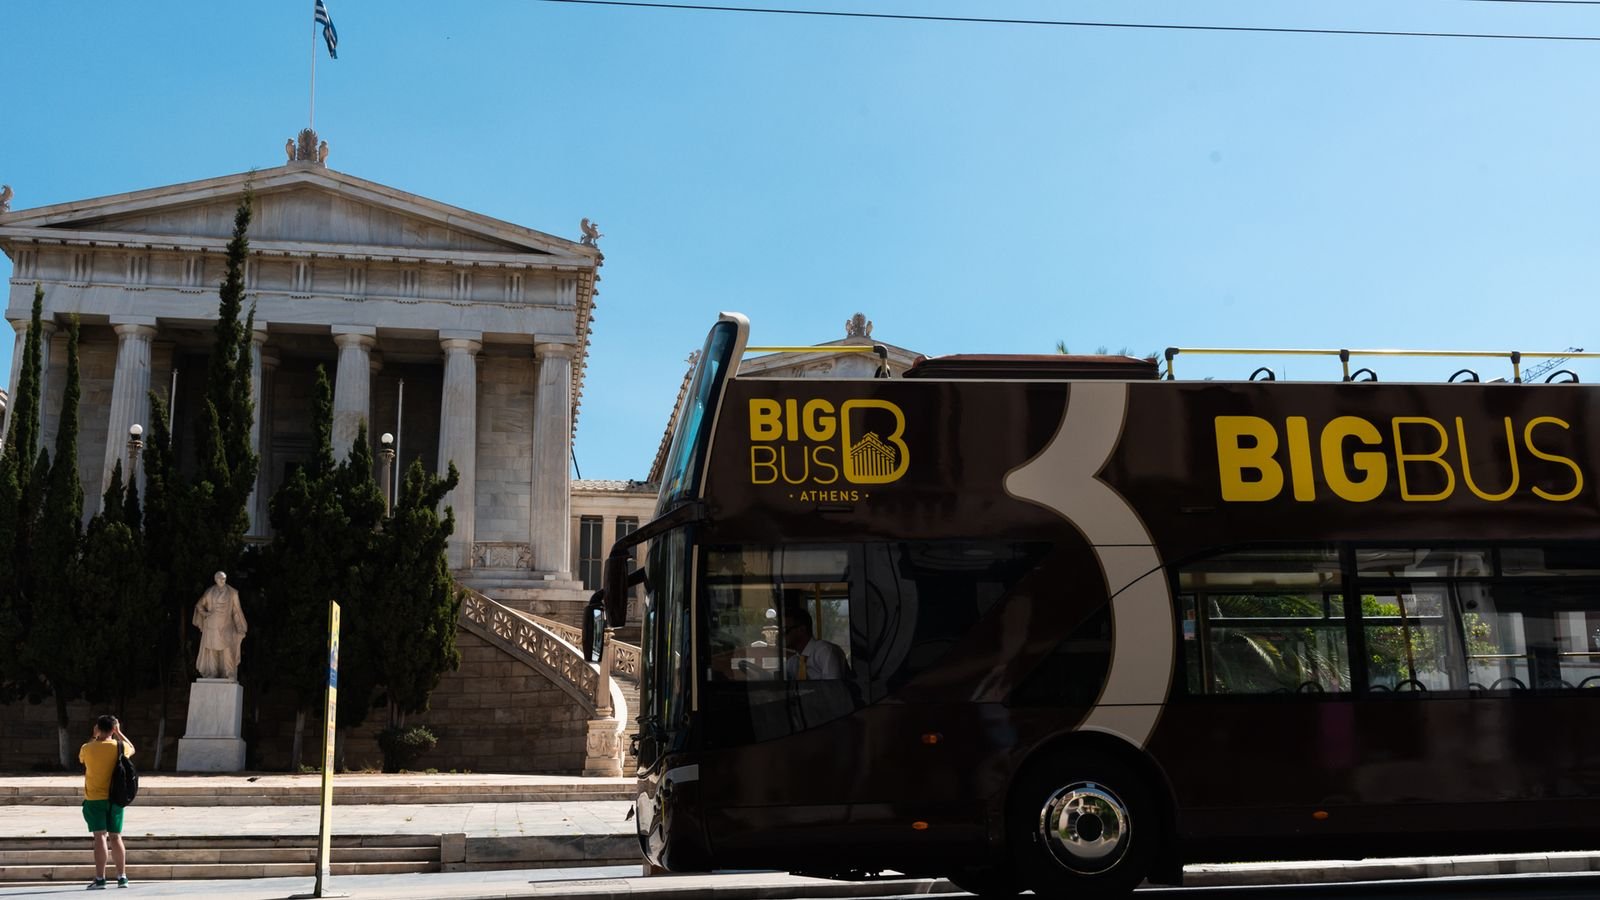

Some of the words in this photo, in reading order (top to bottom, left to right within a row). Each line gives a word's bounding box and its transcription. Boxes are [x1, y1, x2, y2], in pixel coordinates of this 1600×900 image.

[749, 398, 837, 442] BIG
[750, 445, 839, 484] BUS
[800, 490, 859, 502] ATHENS
